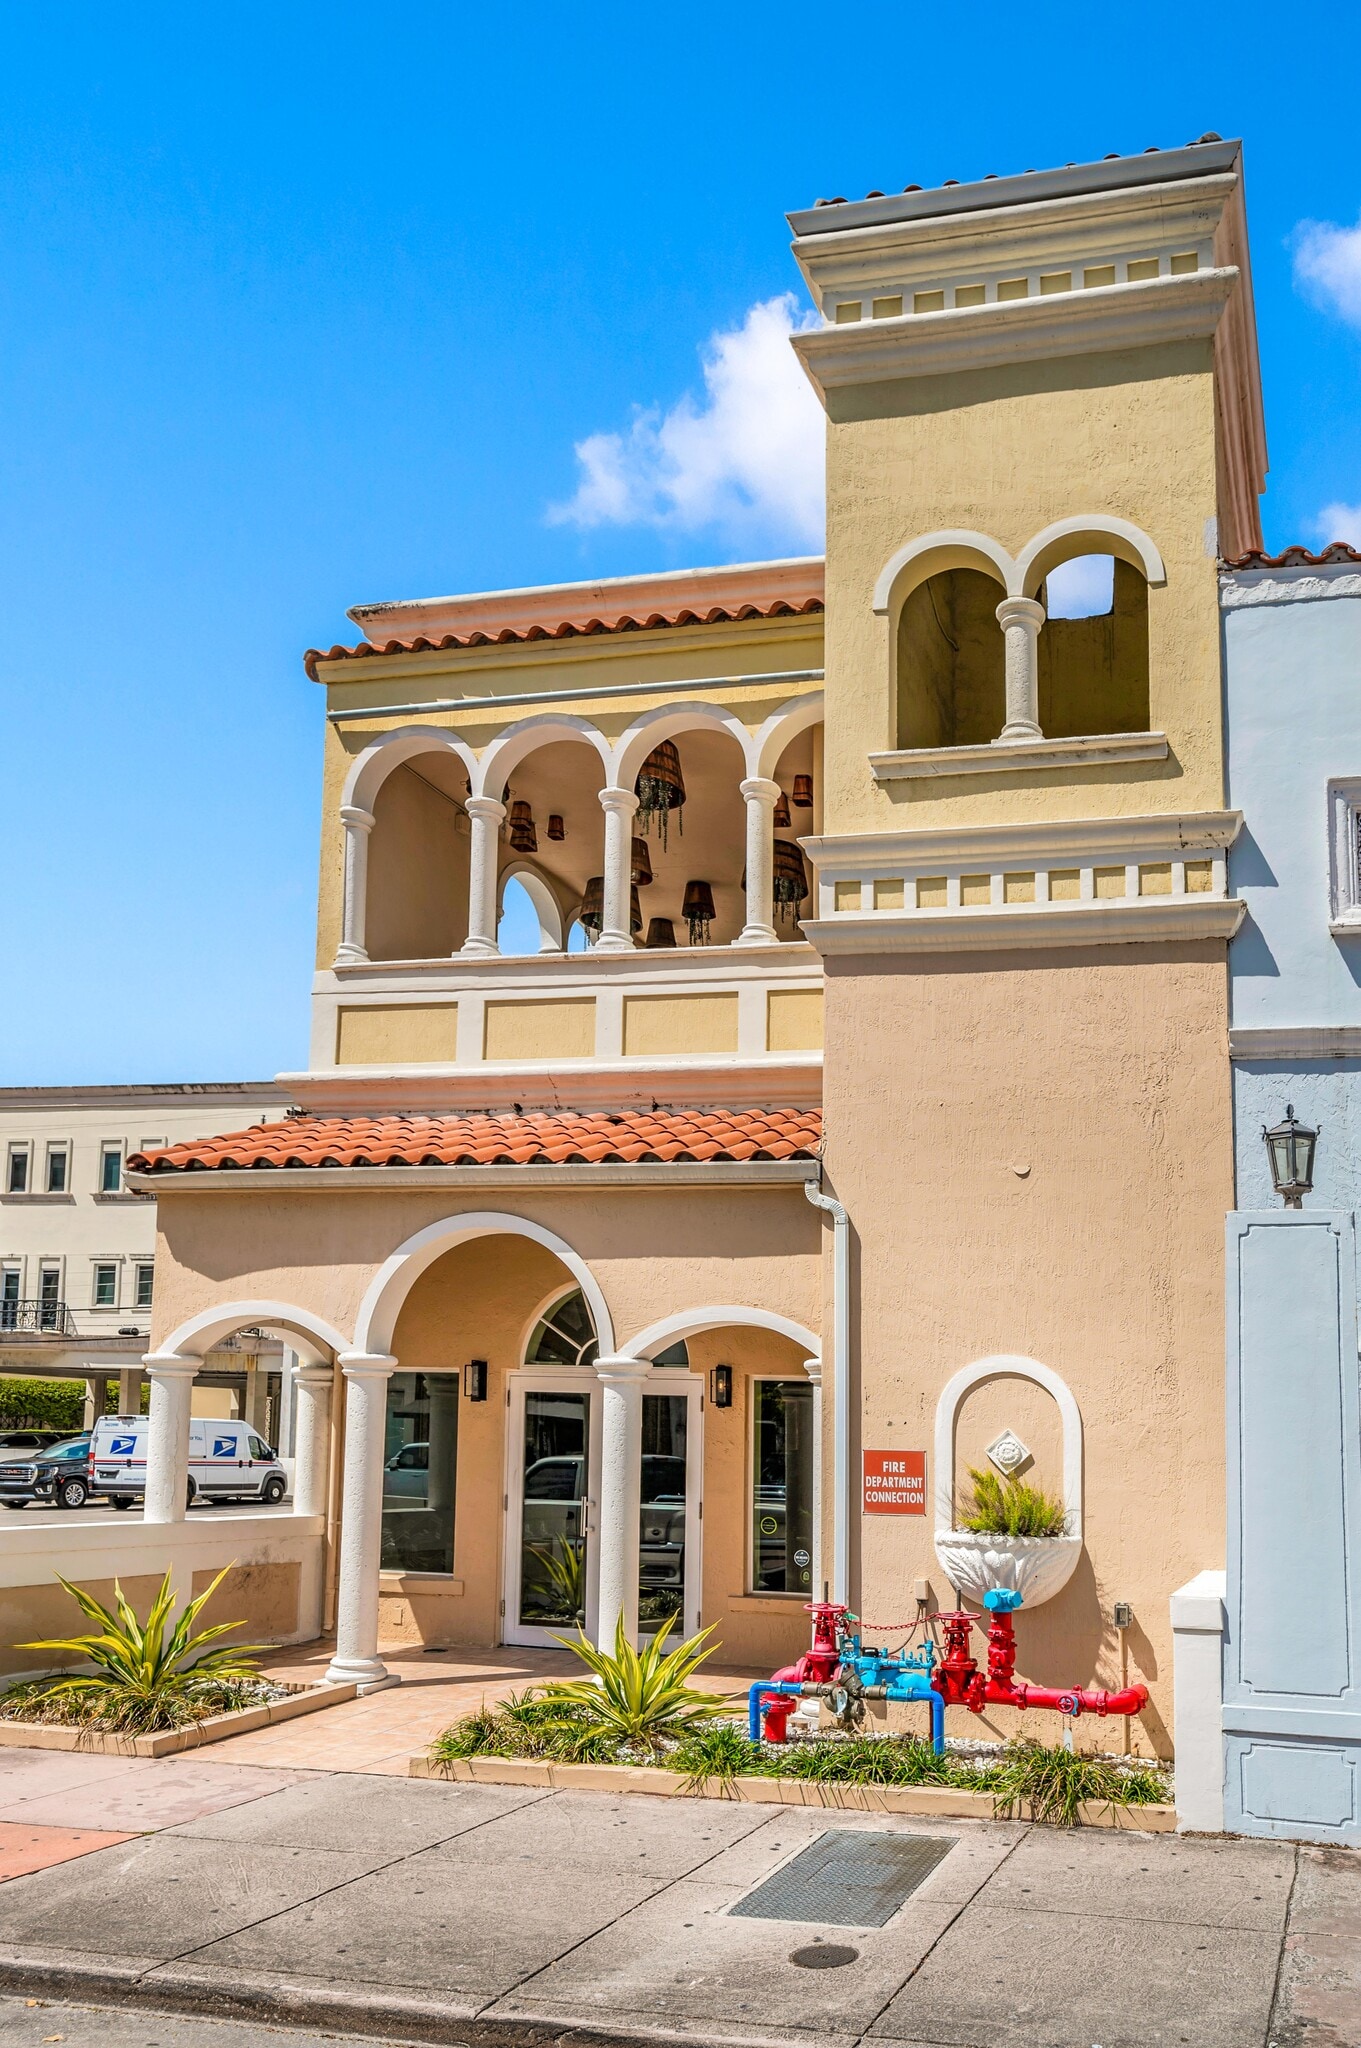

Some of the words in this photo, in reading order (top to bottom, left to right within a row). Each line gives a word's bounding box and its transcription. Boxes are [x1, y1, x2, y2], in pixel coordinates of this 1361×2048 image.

[883, 1461, 906, 1473] FIRE
[866, 1476, 923, 1489] DEPARTMENT
[866, 1491, 924, 1504] CONNECTION
